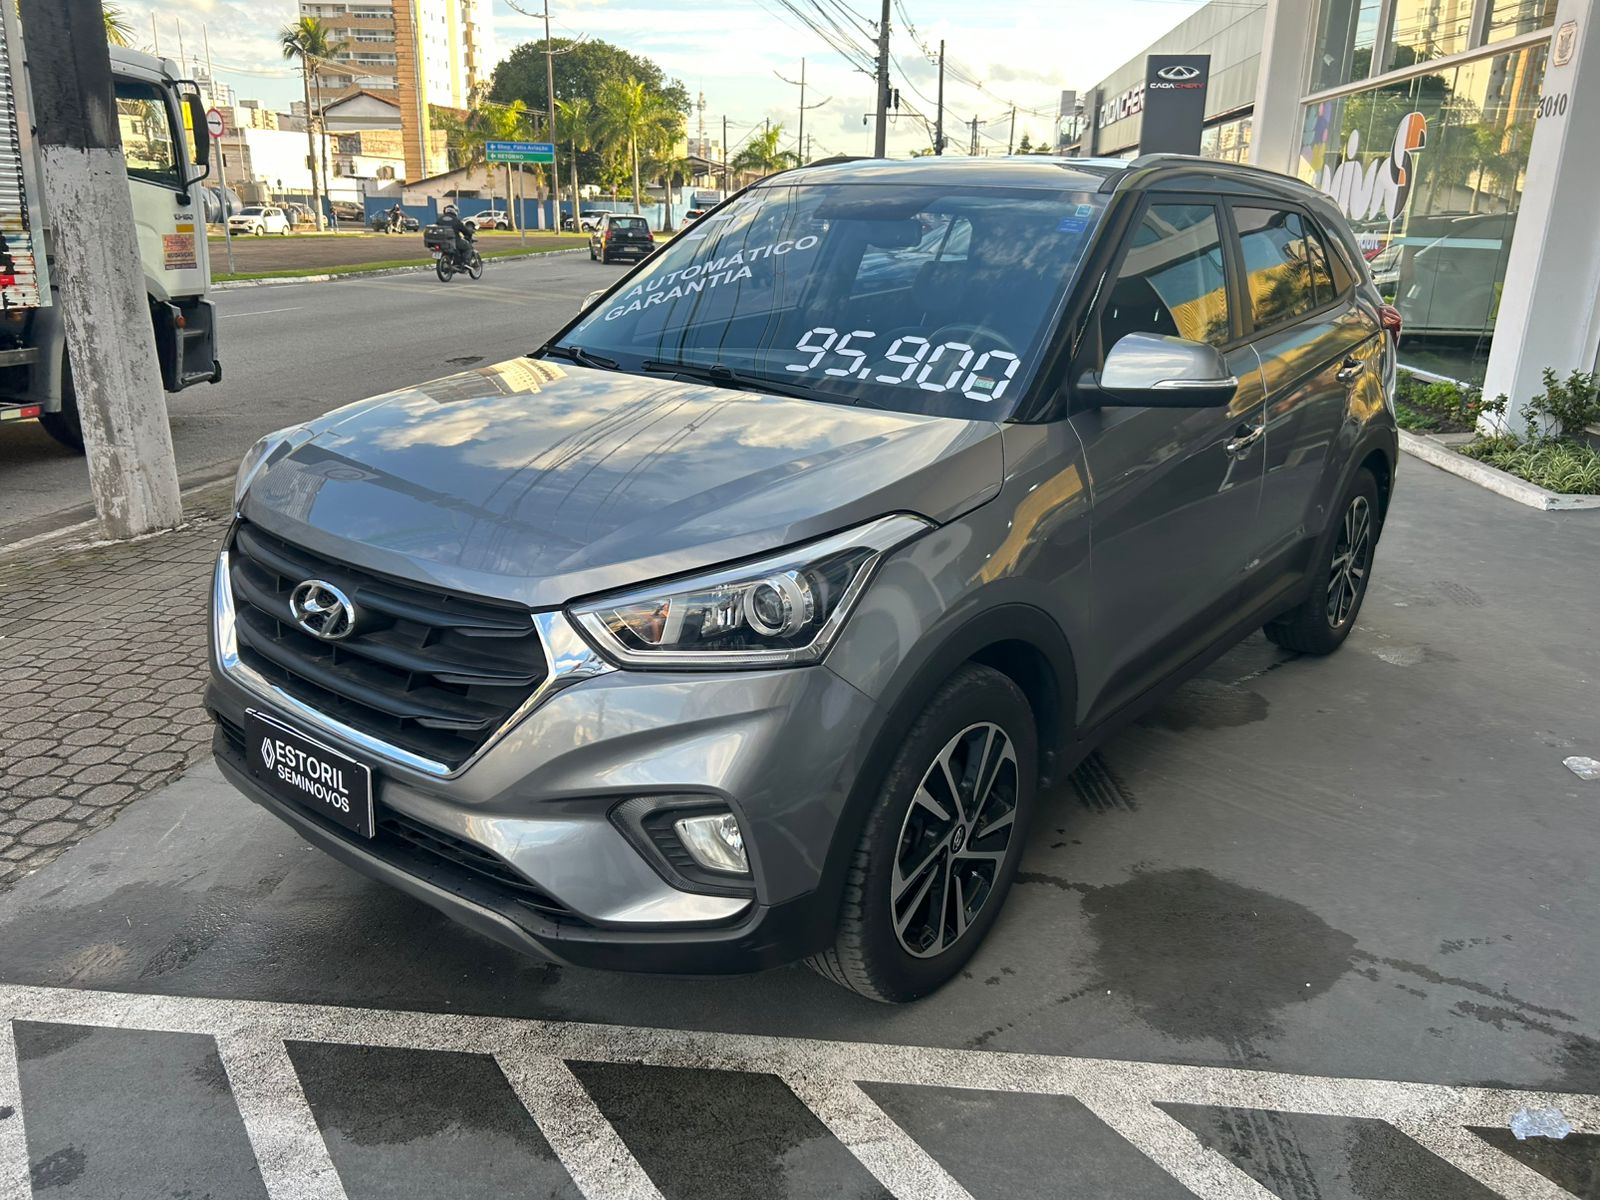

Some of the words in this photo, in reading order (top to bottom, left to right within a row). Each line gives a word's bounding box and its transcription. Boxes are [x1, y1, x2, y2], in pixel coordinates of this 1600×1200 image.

[1537, 93, 1567, 118] 3010
[605, 266, 752, 321] GARANTIA
[625, 235, 818, 300] AUTOMÁTICO
[276, 740, 349, 795] ESTORIL
[277, 764, 350, 813] SEMINOVOS
